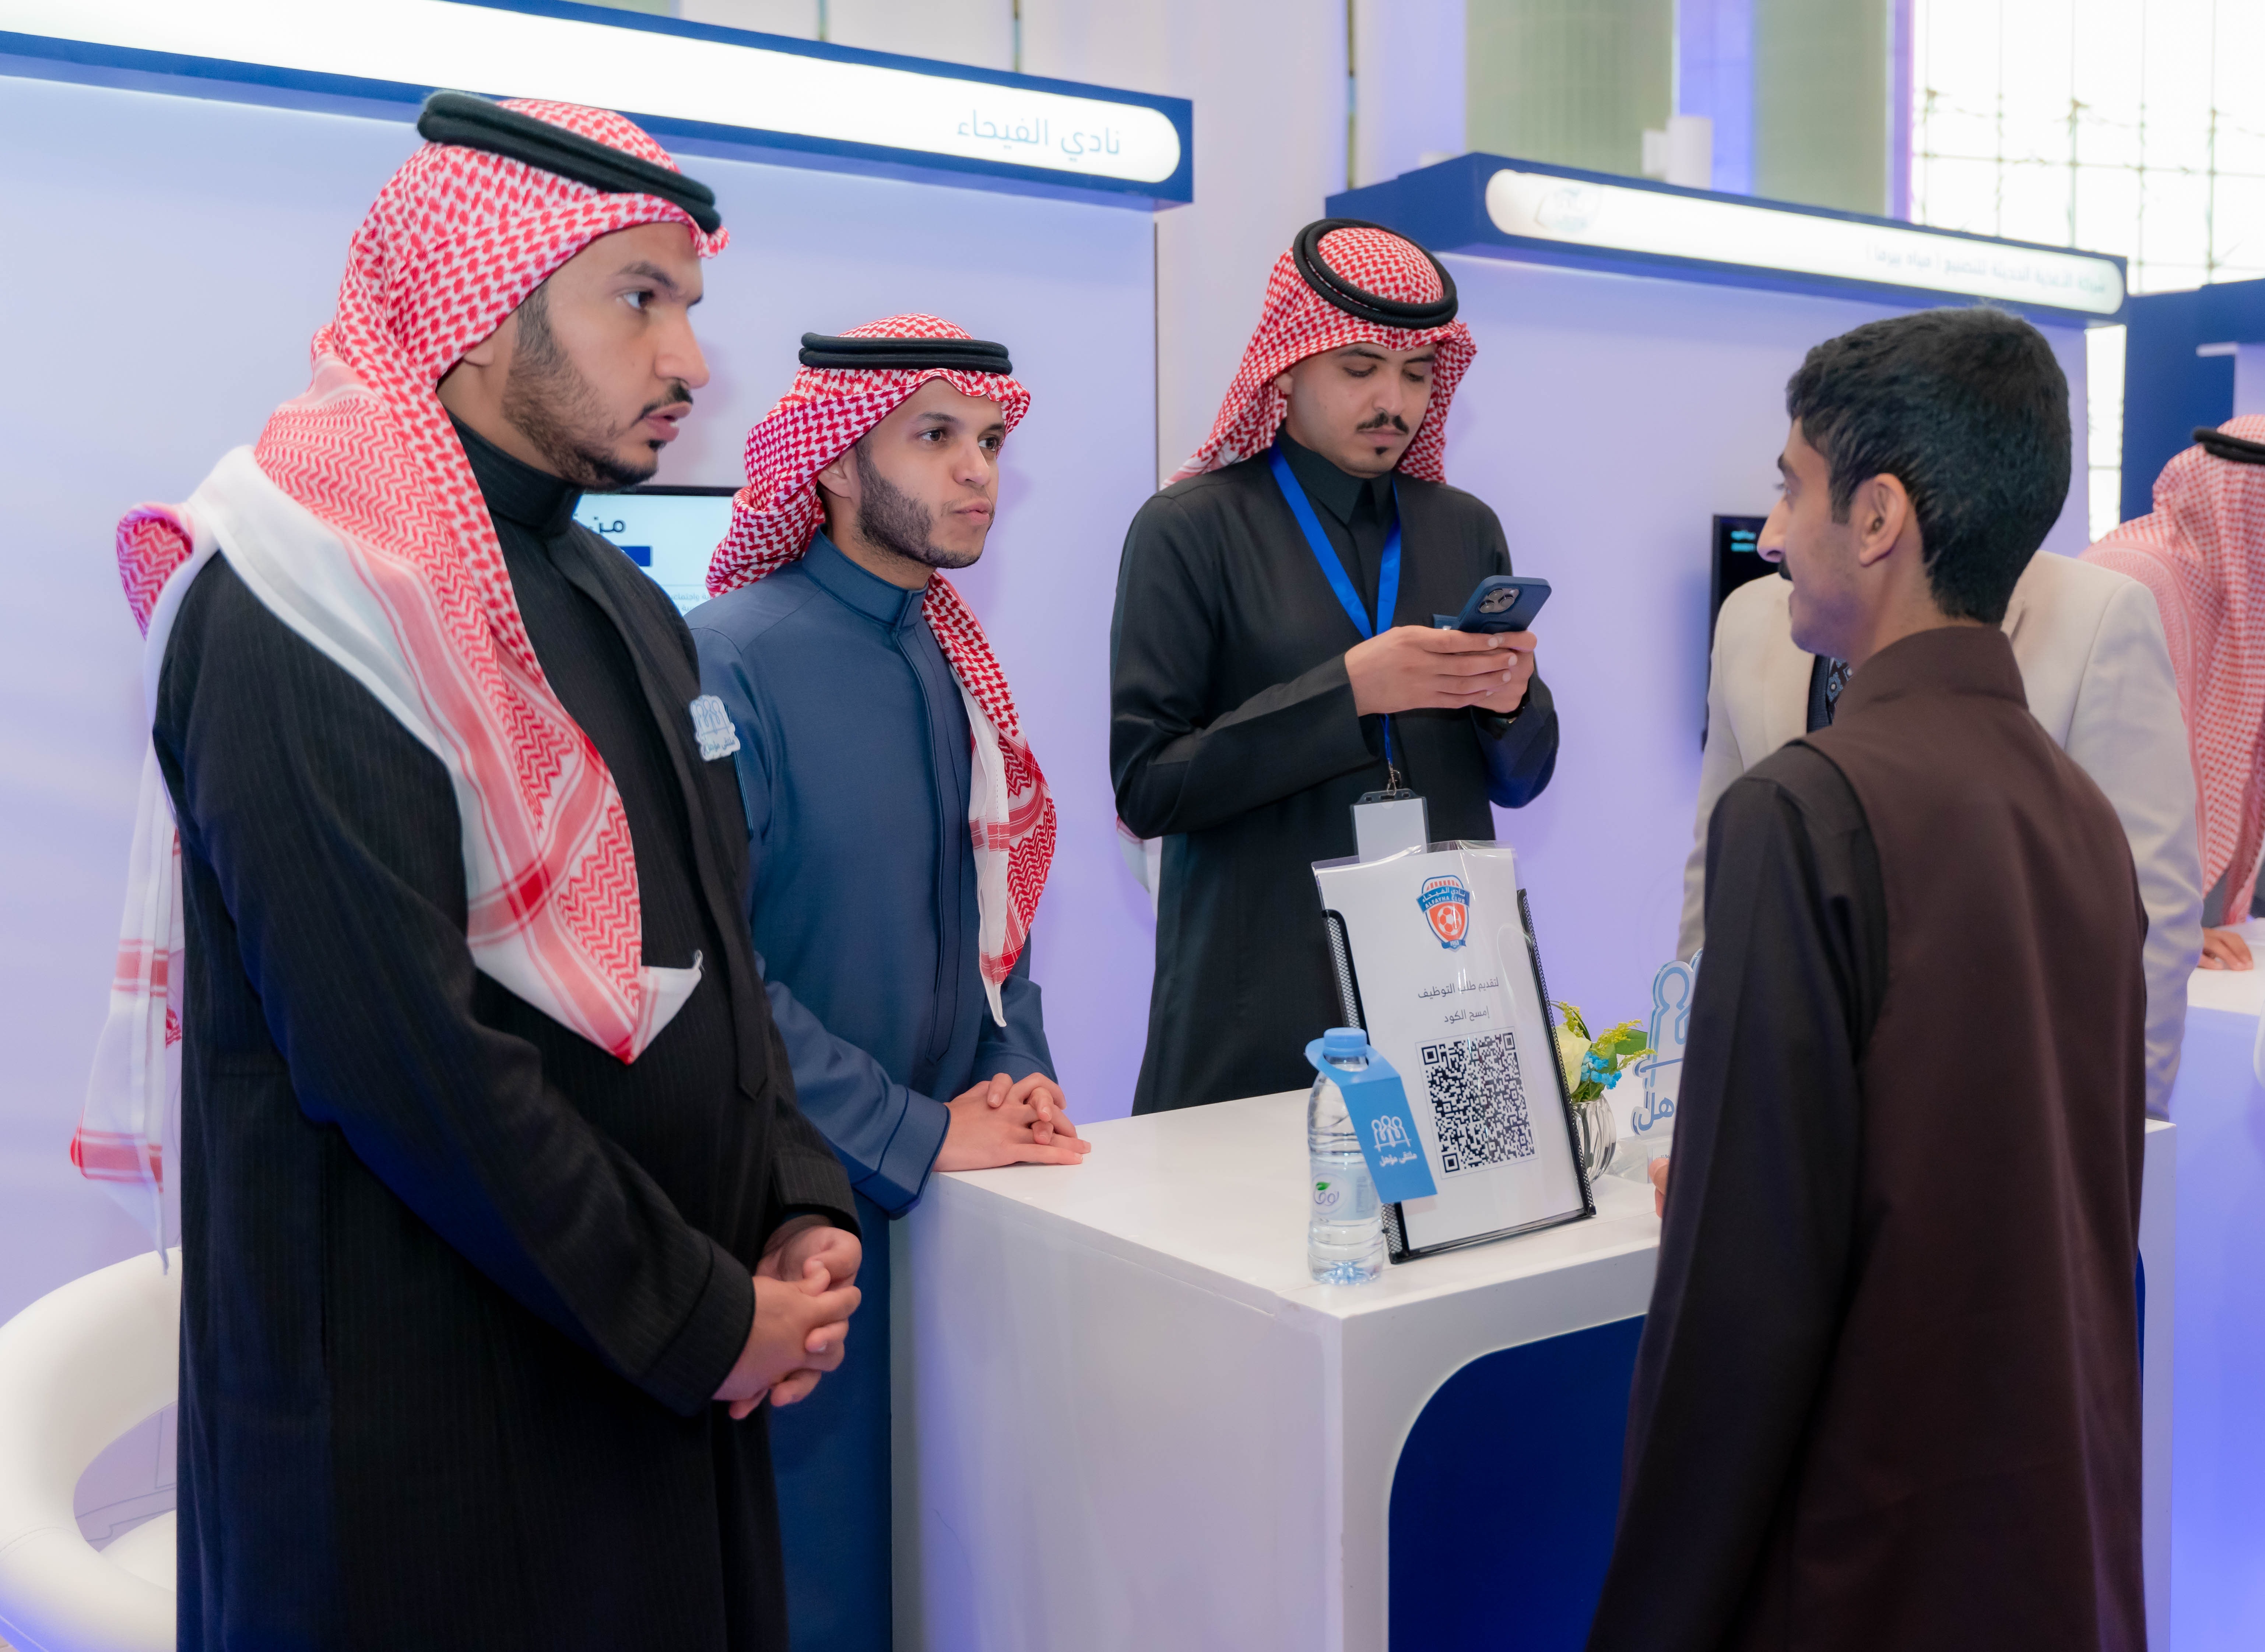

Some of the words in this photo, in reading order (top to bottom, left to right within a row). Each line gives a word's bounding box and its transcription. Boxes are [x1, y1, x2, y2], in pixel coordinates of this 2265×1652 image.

[956, 109, 1049, 149] الفيحاء
[1061, 127, 1120, 162] نادي
[1425, 895, 1450, 909] ALFAYHA
[1451, 895, 1465, 904] CLUB
[1418, 983, 1455, 999] التوظيف
[1457, 980, 1476, 994] طلب
[1478, 977, 1499, 992] لتقديم
[1444, 1008, 1467, 1024] الكود
[1469, 1005, 1490, 1021] إمسح
[1638, 1092, 1675, 1131] هل
